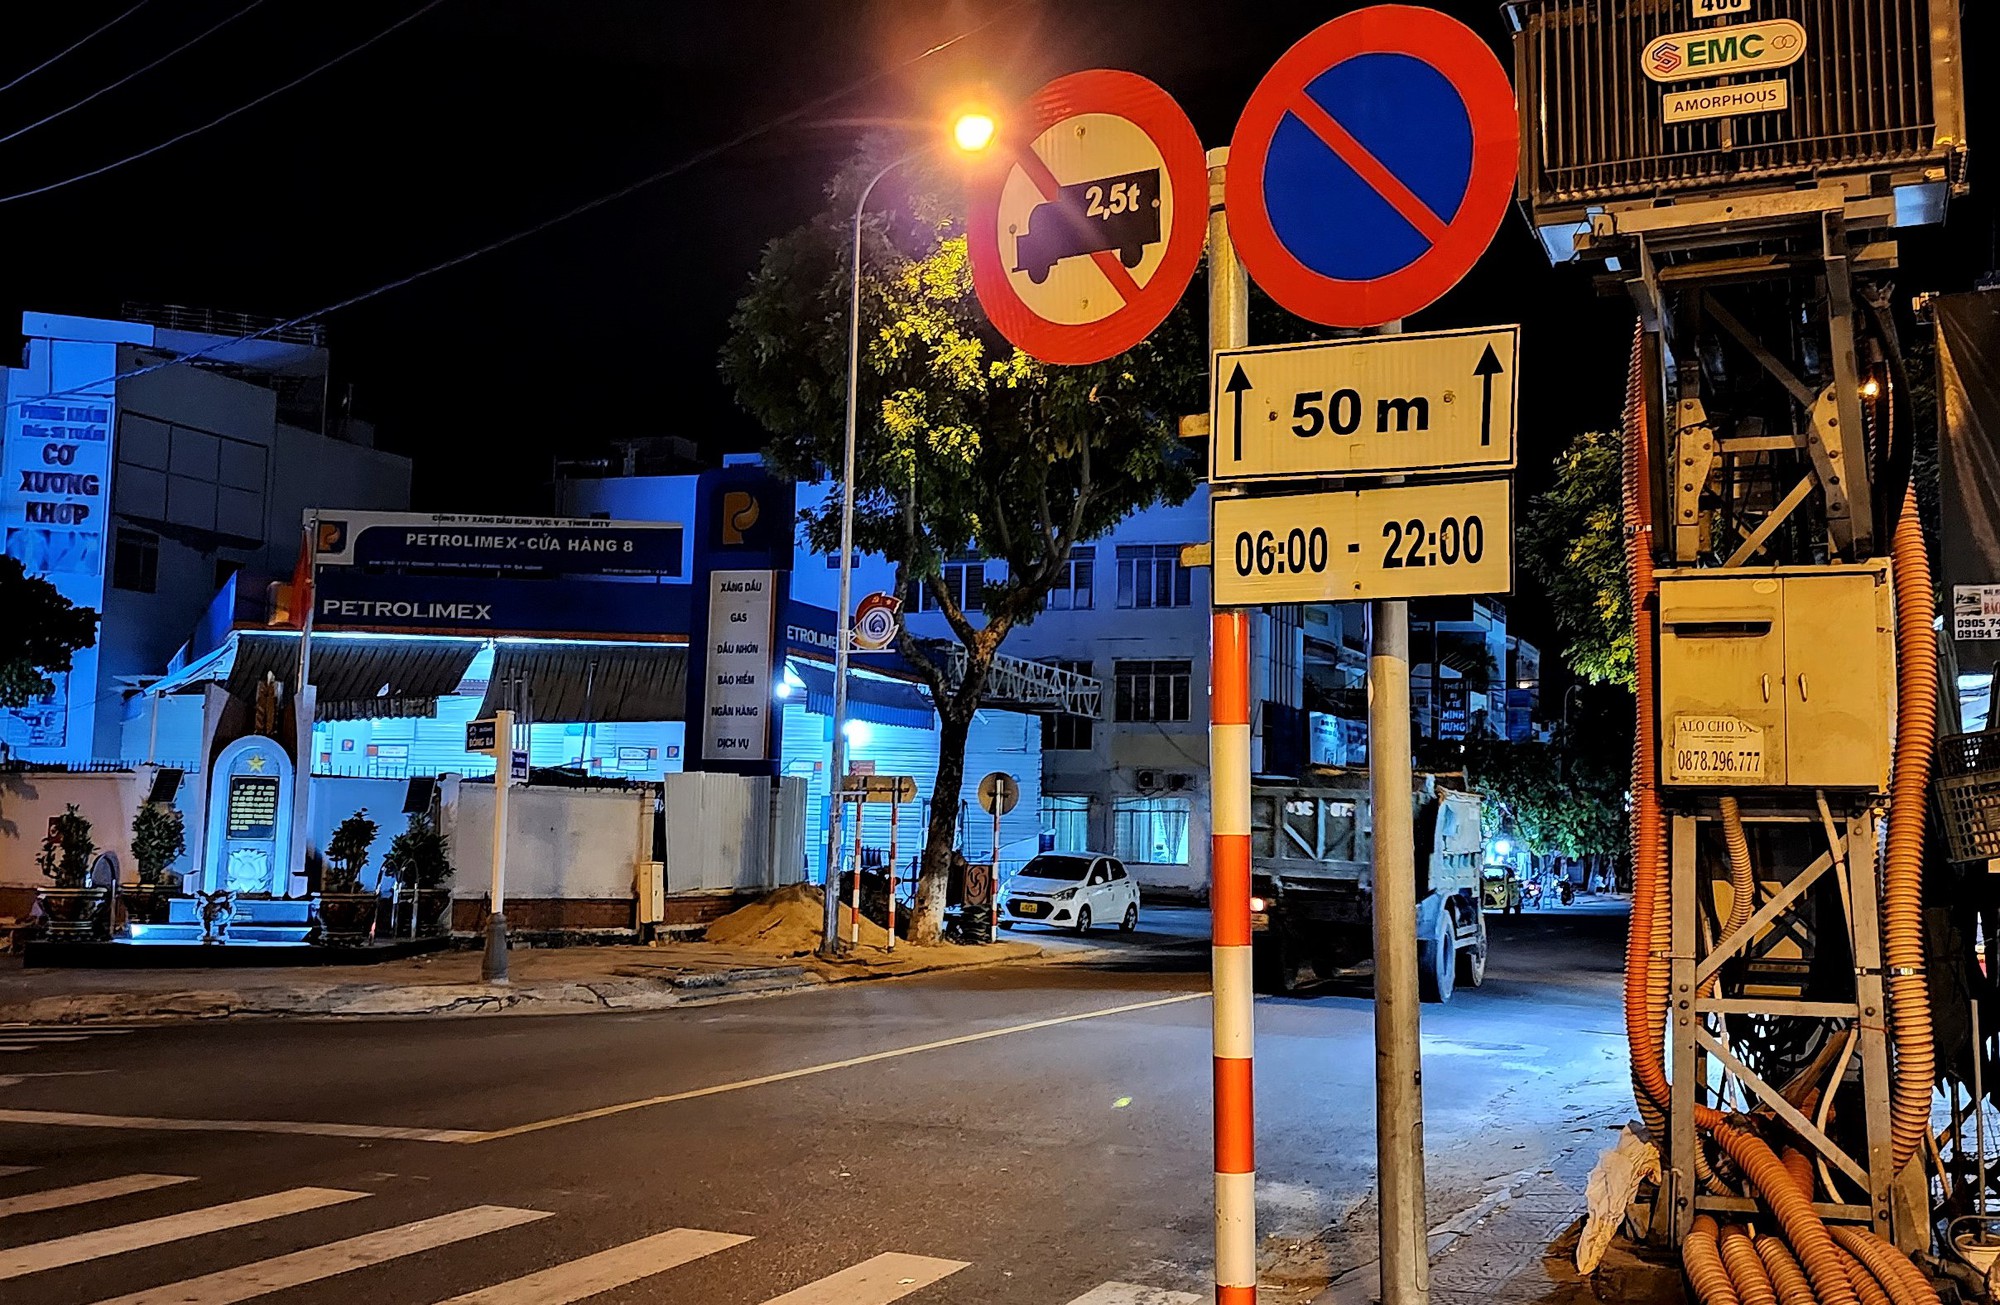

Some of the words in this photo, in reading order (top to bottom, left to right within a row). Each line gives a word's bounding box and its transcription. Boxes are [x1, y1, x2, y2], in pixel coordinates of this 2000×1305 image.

[1687, 34, 1765, 67] EMC
[1674, 89, 1777, 113] AMORPHOUS
[1085, 182, 1140, 220] 2,5t
[1292, 388, 1362, 438] 50
[1376, 395, 1429, 433] m
[42, 443, 80, 466] CƠ
[18, 470, 100, 496] XƯƠNG
[25, 497, 90, 525] KHỚP
[568, 535, 618, 552] HÀNG
[623, 540, 634, 552] 8
[1235, 527, 1328, 577] 06:00
[1382, 515, 1484, 569] 22:00
[323, 600, 492, 621] PETROLIMEX
[730, 612, 748, 622] GAS
[1957, 618, 1986, 628] 0905
[1957, 629, 1991, 639] 09194
[1680, 720, 1704, 732] ALO
[1707, 720, 1734, 732] CHO
[1678, 750, 1760, 772] 0878.296.777
